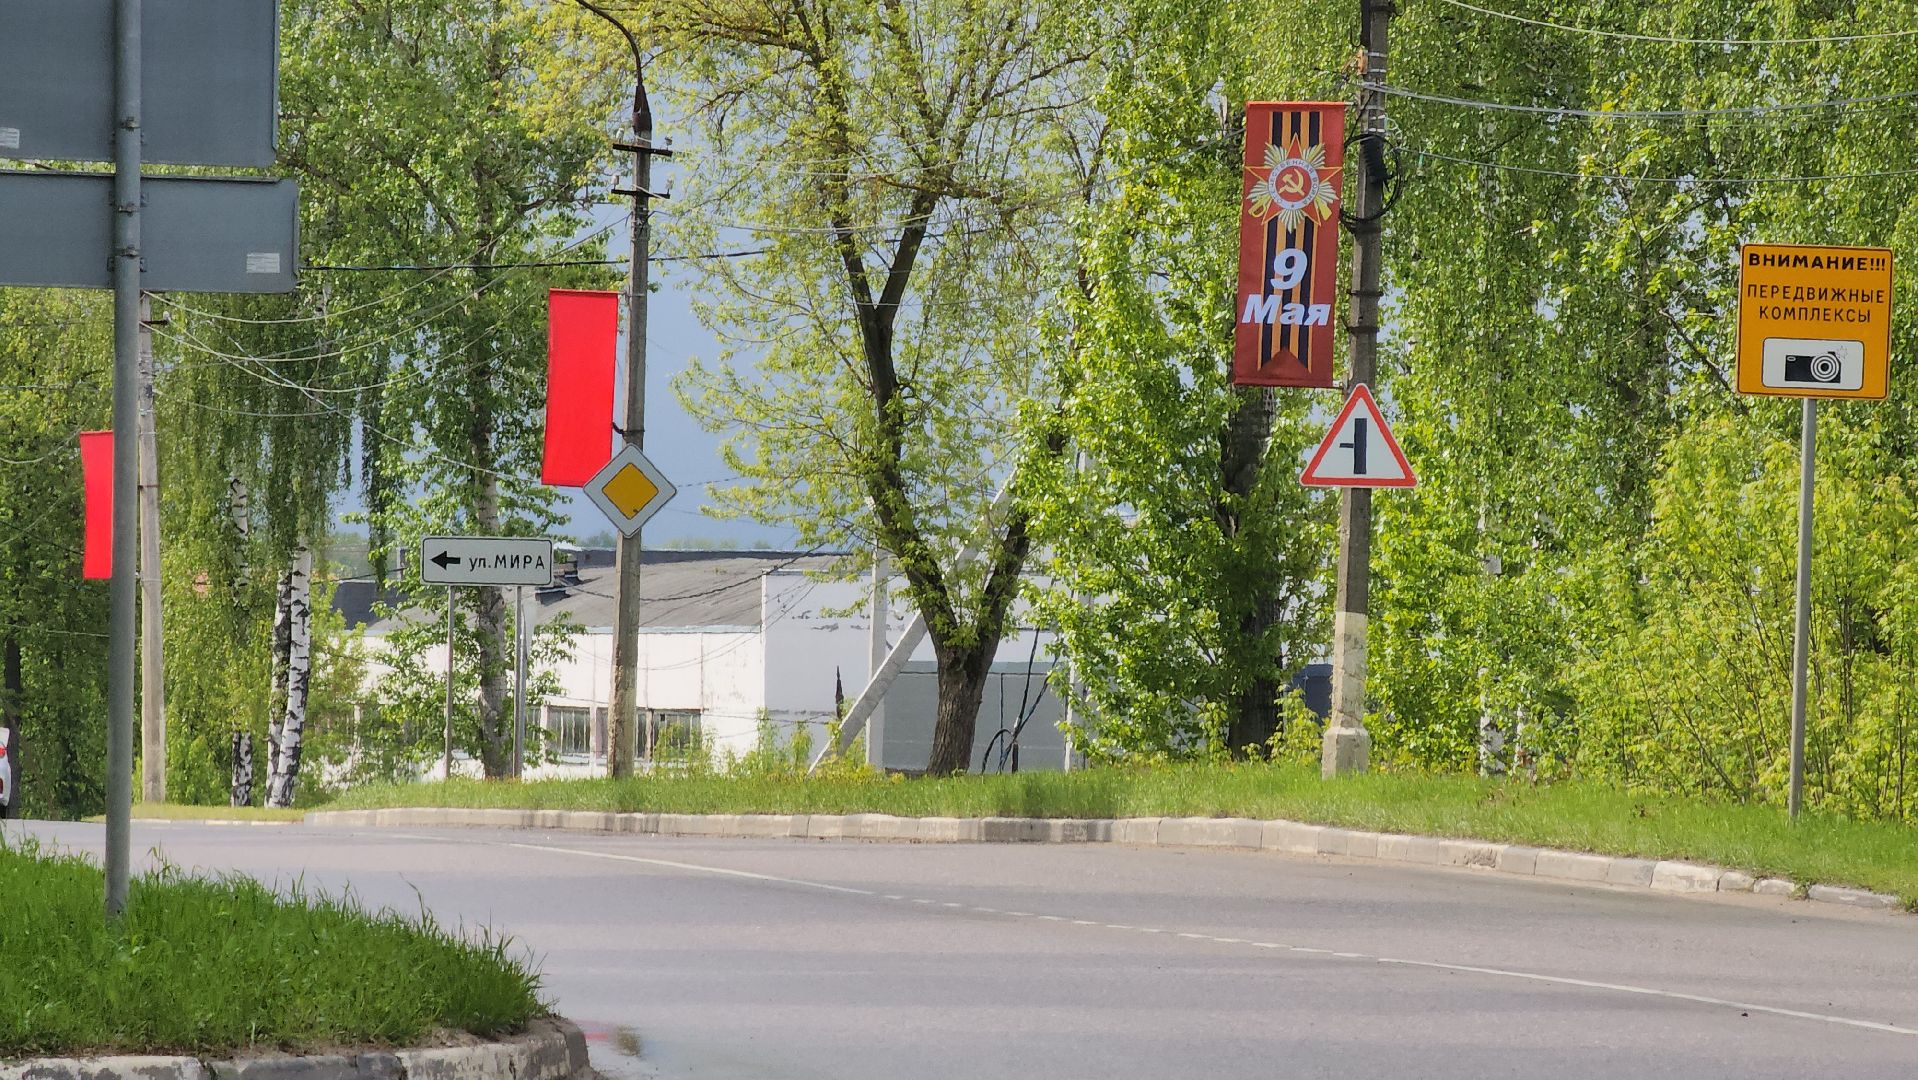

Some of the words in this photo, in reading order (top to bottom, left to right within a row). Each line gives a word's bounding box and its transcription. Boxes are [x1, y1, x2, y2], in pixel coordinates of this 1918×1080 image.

[1271, 248, 1308, 291] 9
[1748, 253, 1886, 272] ВНИМАНИЕ!!!
[1747, 284, 1885, 304] ПЕРЕДВИЖНЫЕ
[1241, 294, 1331, 326] Мая
[1759, 306, 1871, 323] КОМПЛЕКСЫ
